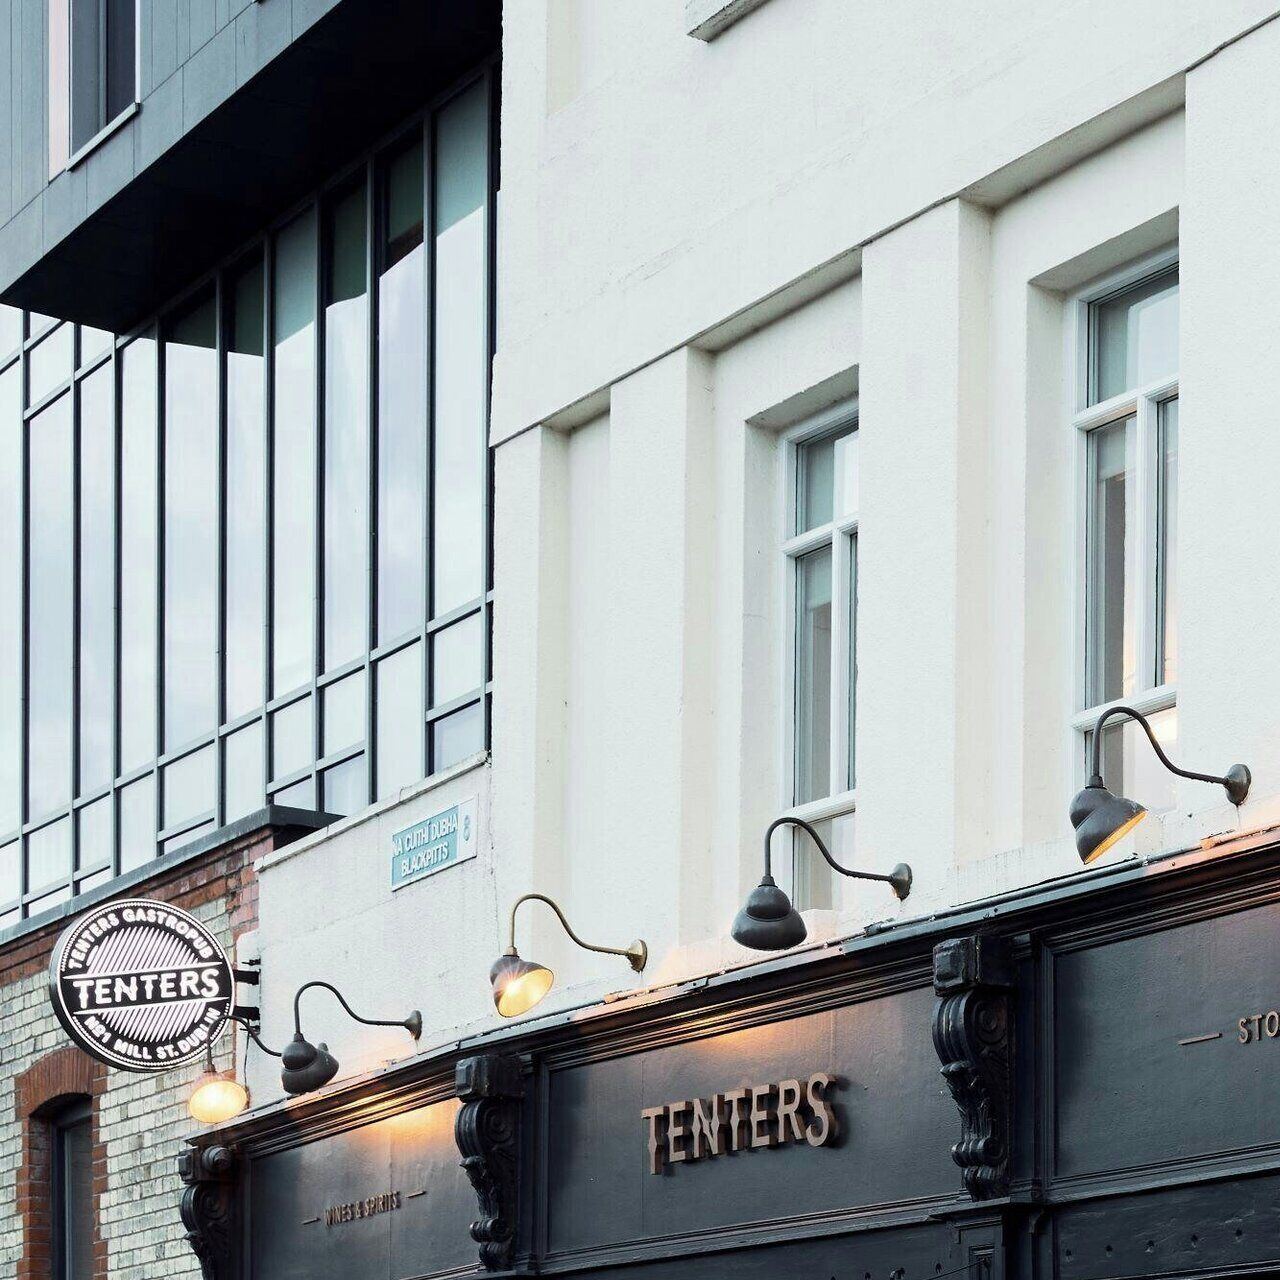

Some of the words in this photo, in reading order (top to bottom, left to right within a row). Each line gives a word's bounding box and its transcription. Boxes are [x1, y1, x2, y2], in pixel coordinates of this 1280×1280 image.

[430, 814, 458, 839] DUBHA
[401, 841, 449, 877] BLACKPITTS
[68, 913, 119, 969] TENTERS
[122, 908, 213, 959] GASTROPUB
[72, 968, 220, 1009] TENTERS
[113, 1038, 152, 1059] MILL
[157, 1043, 179, 1059] ST.
[177, 1008, 221, 1053] DUBLIN
[642, 1072, 838, 1175] TENTERS
[325, 1203, 352, 1226] WINES
[355, 1200, 362, 1218] &
[364, 1190, 398, 1217] SPIRITS
